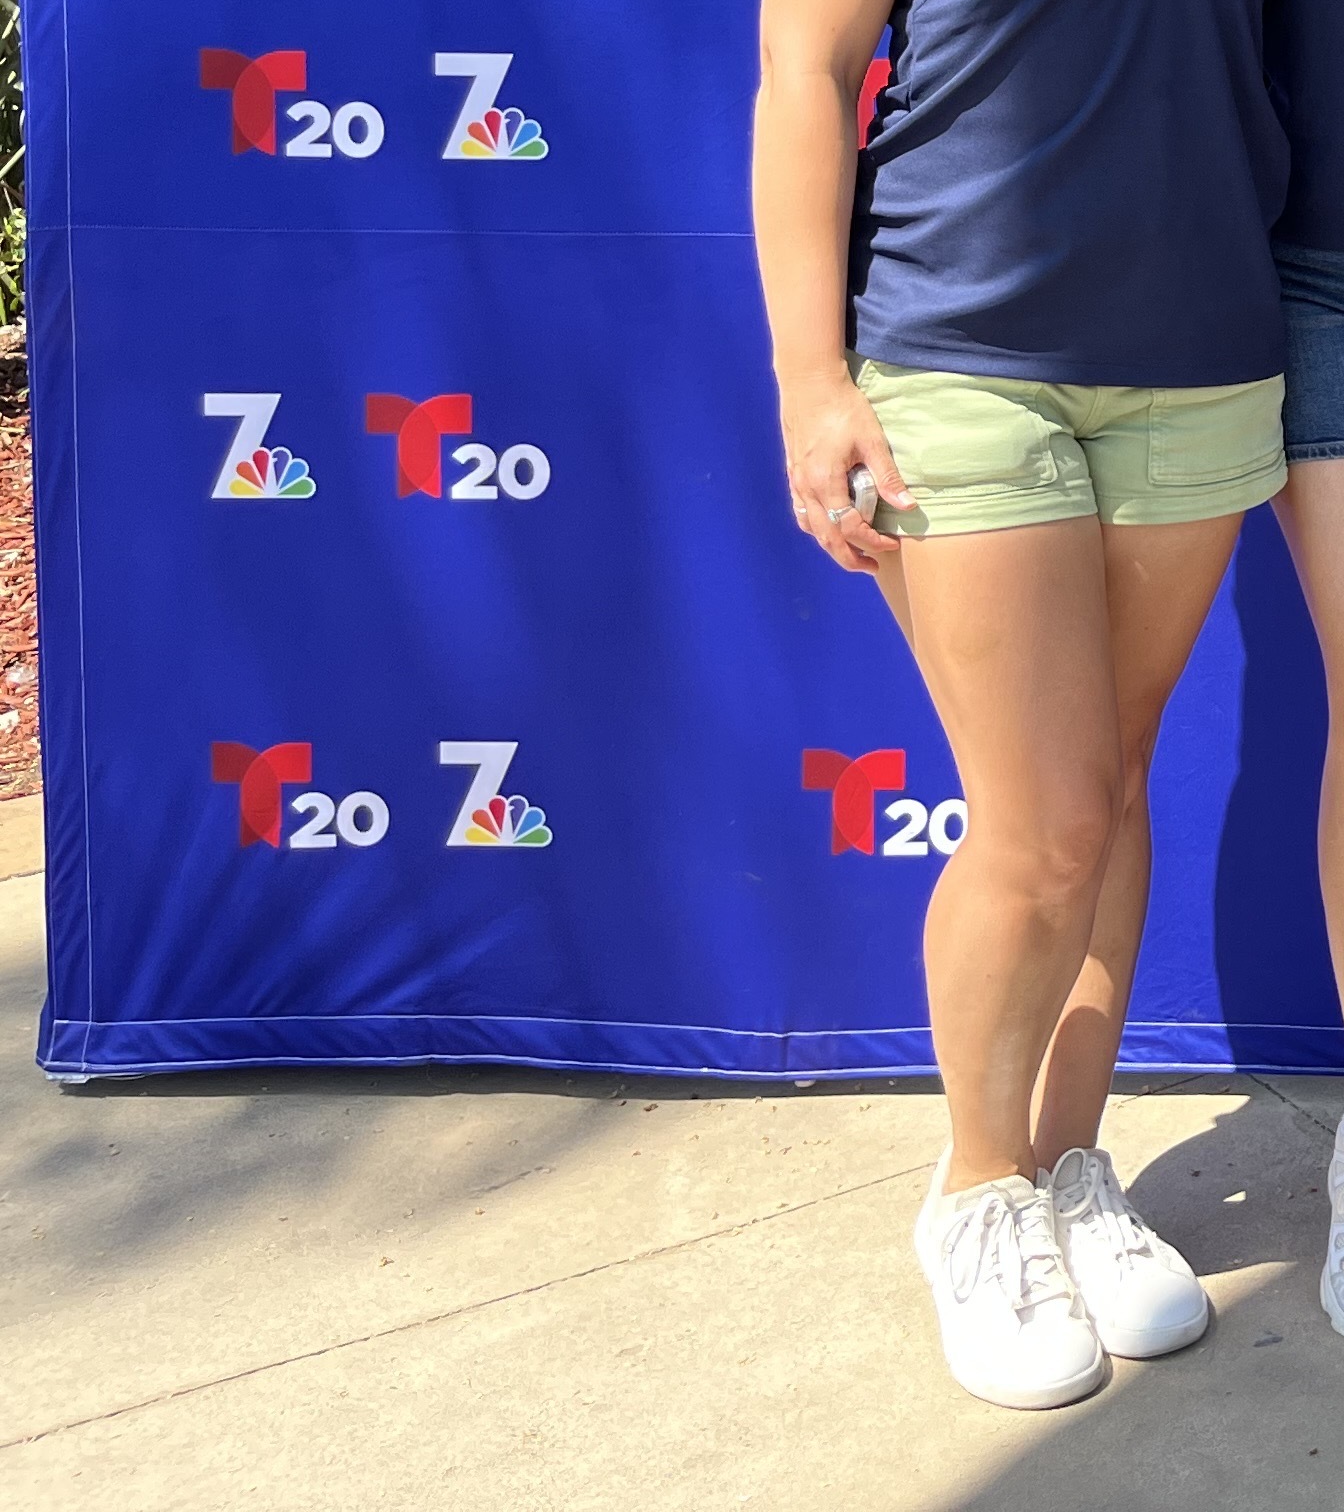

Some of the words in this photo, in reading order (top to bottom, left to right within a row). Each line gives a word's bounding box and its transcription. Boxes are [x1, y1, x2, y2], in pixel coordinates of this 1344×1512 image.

[434, 52, 514, 160] 7
[203, 392, 282, 499] 7
[439, 740, 519, 847] 7
